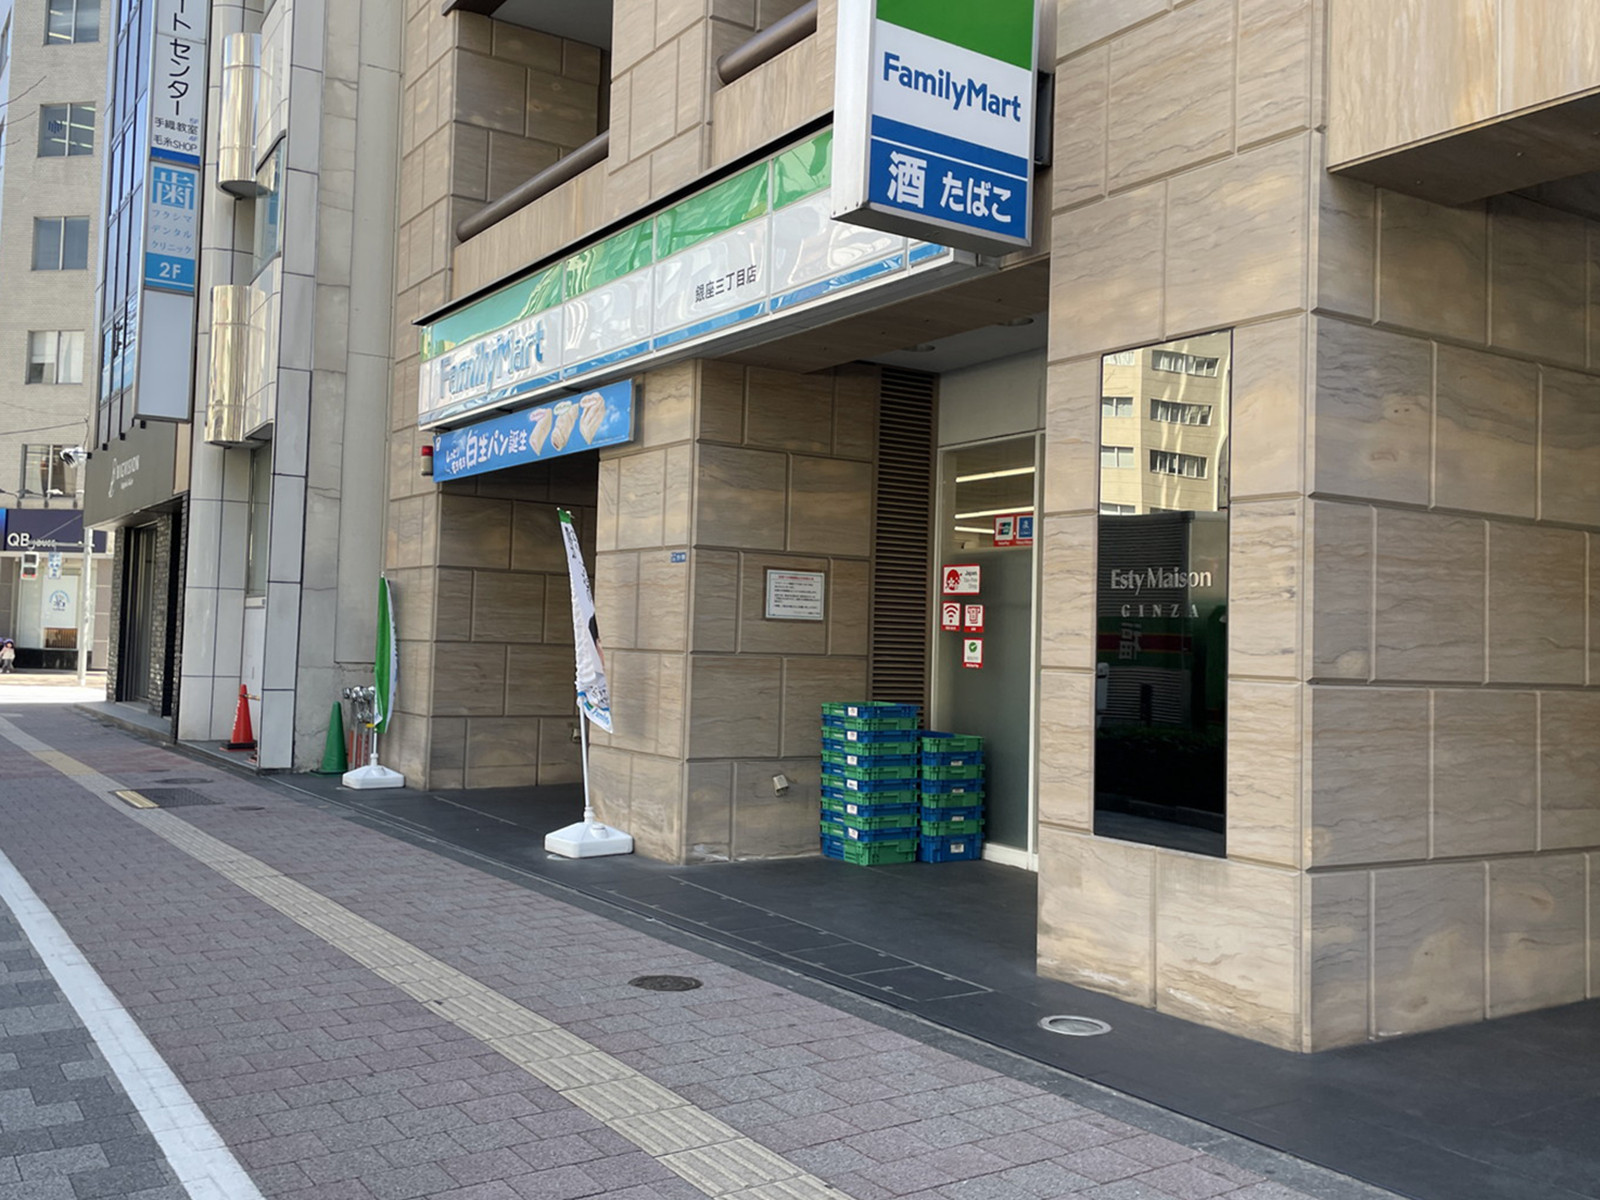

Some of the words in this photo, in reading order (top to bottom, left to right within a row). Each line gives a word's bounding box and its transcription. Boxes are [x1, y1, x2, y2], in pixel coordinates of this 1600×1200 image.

[883, 51, 1021, 122] FamilyMart
[155, 117, 198, 135] 手織教室
[154, 134, 198, 152] 毛糸SHOP
[155, 170, 195, 209] 歯
[887, 150, 927, 209] 酒
[939, 171, 1012, 223] たばこ
[151, 240, 192, 254] クリニック
[159, 262, 182, 279] 2F
[695, 264, 757, 303] 銀座三丁目店
[441, 319, 545, 399] FamilyMart
[7, 532, 30, 547] QB
[1111, 569, 1145, 595] Esty
[1147, 567, 1212, 589] Maison
[1121, 604, 1199, 618] GINZA
